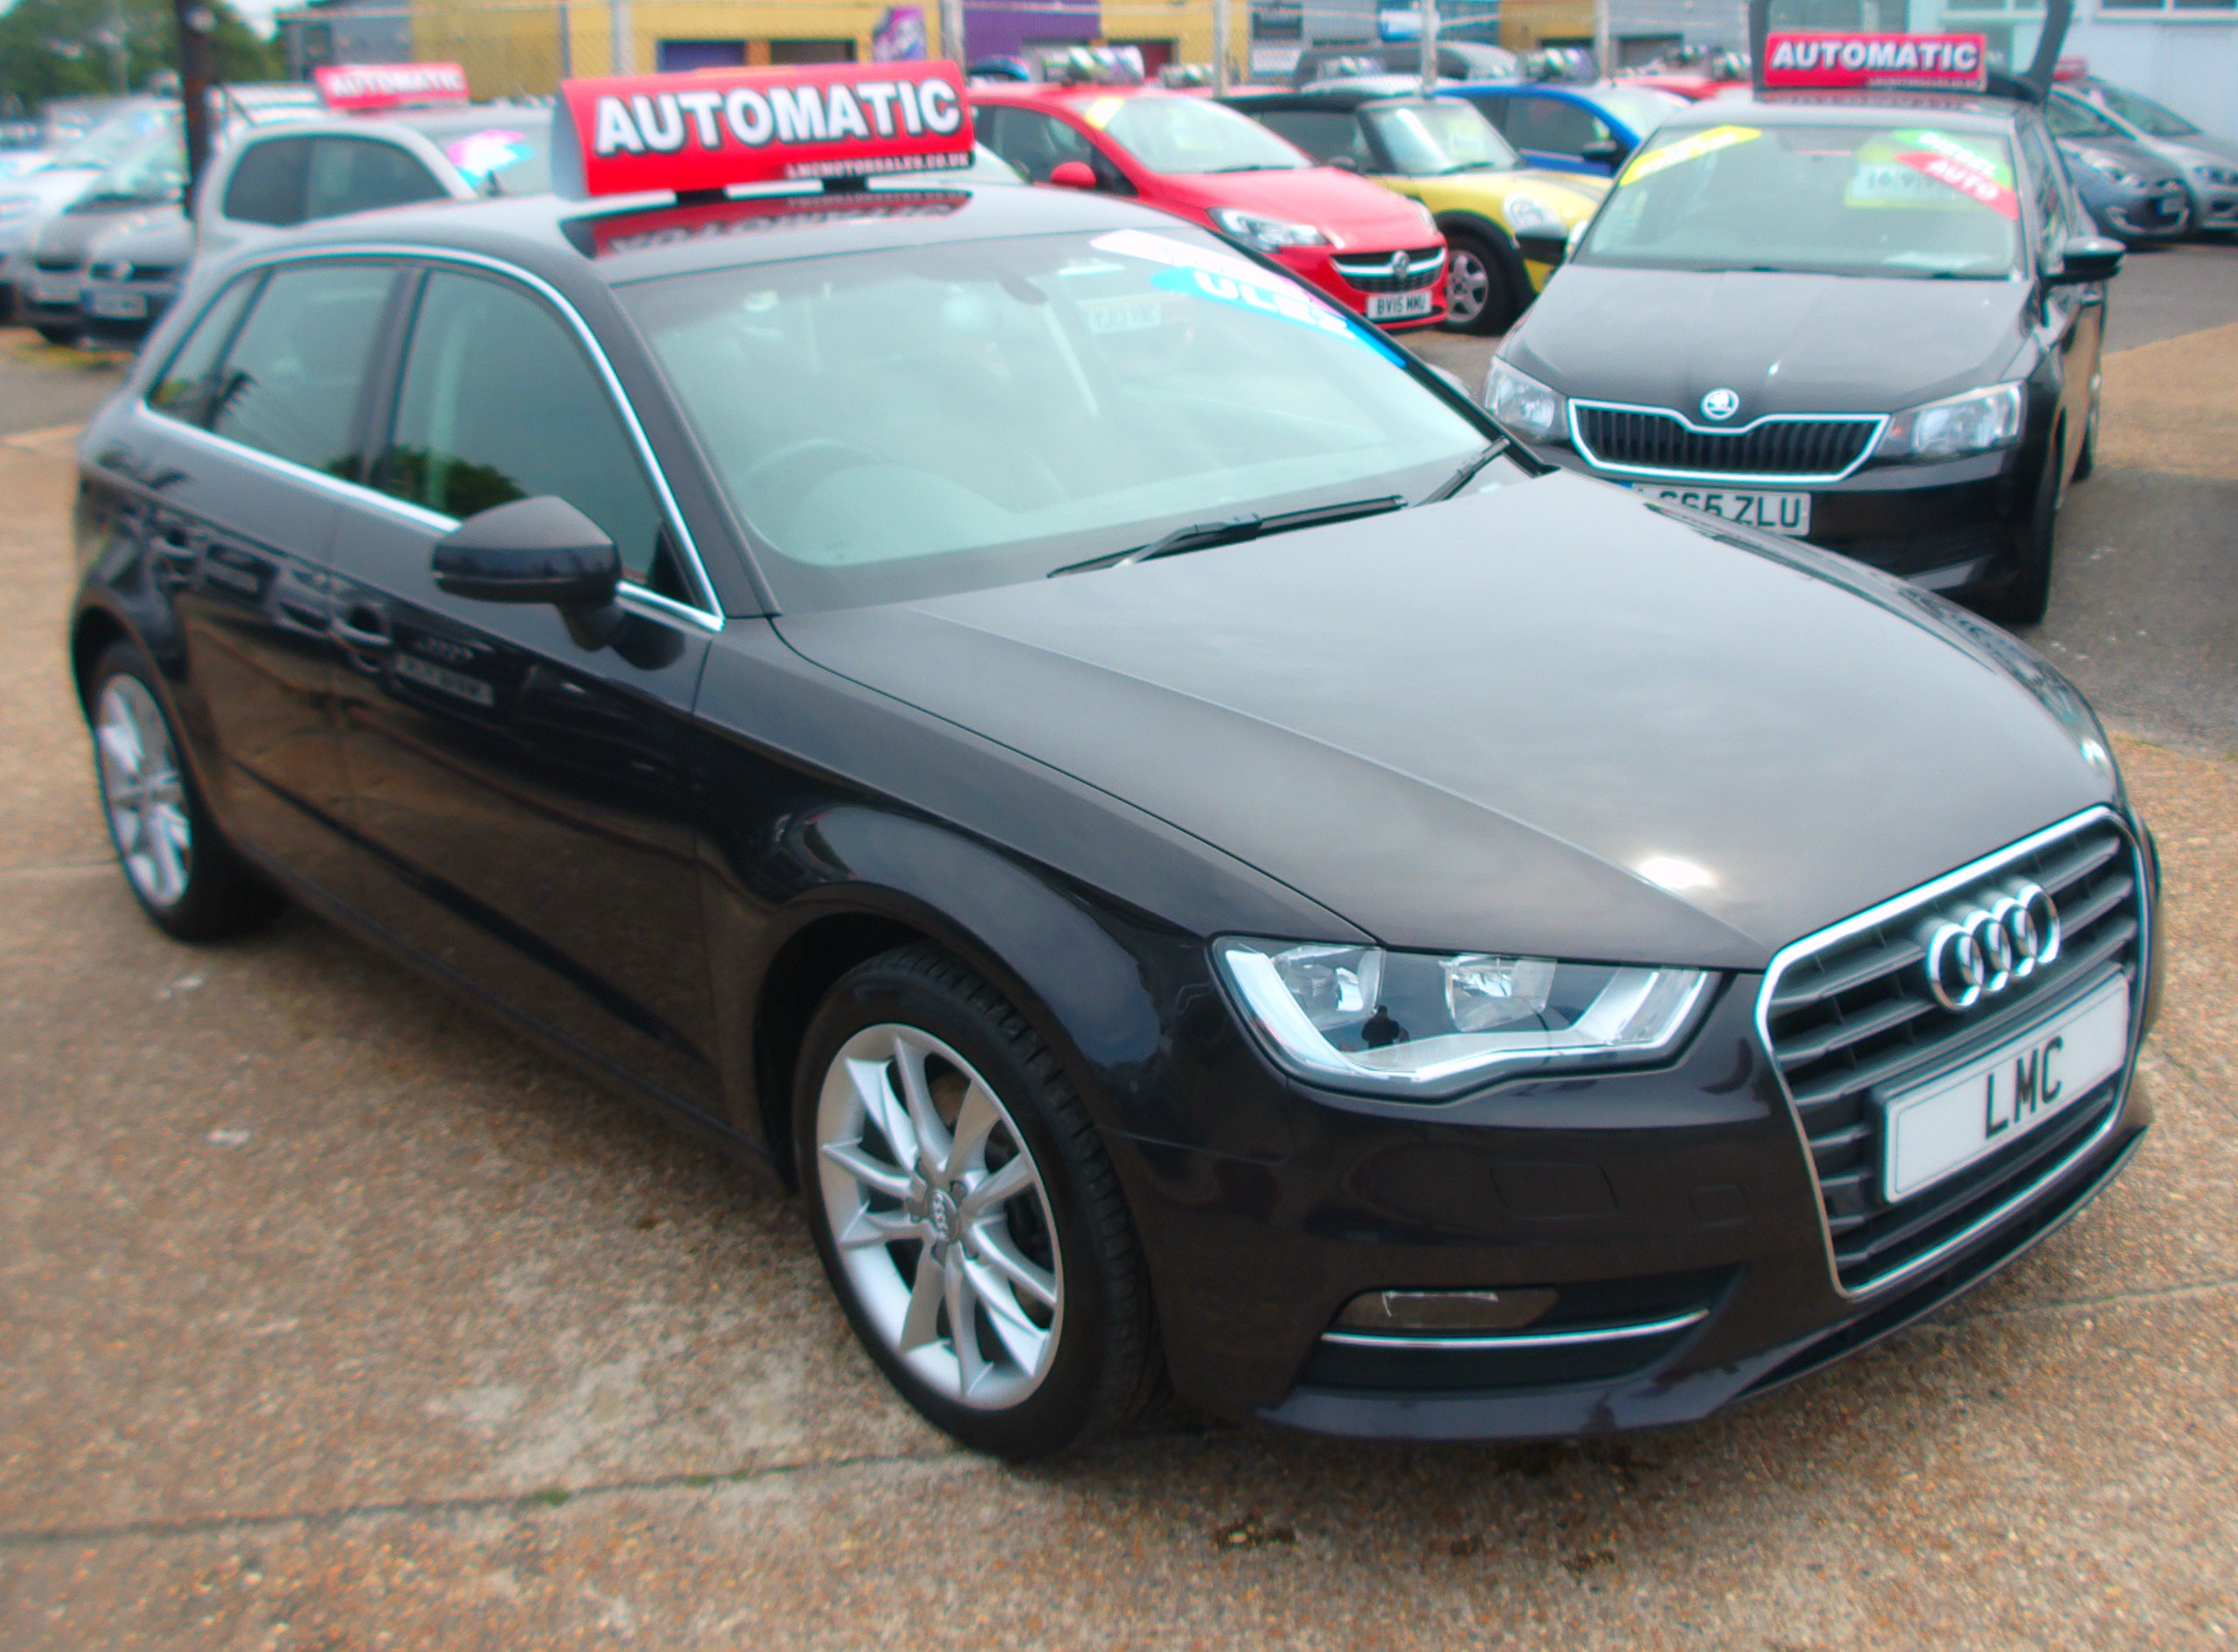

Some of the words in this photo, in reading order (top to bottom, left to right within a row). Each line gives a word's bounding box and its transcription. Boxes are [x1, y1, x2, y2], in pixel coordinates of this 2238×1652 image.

[1772, 41, 1978, 71] AUTOMATIC
[330, 66, 465, 97] AUTOMATIC
[595, 78, 961, 155] AUTOMATIC
[1917, 132, 1997, 177] DIESEL
[1926, 159, 1999, 200] AUTO
[1377, 297, 1404, 315] BV15
[1734, 496, 1801, 528] ZLU
[1984, 1035, 2064, 1139] LMC
